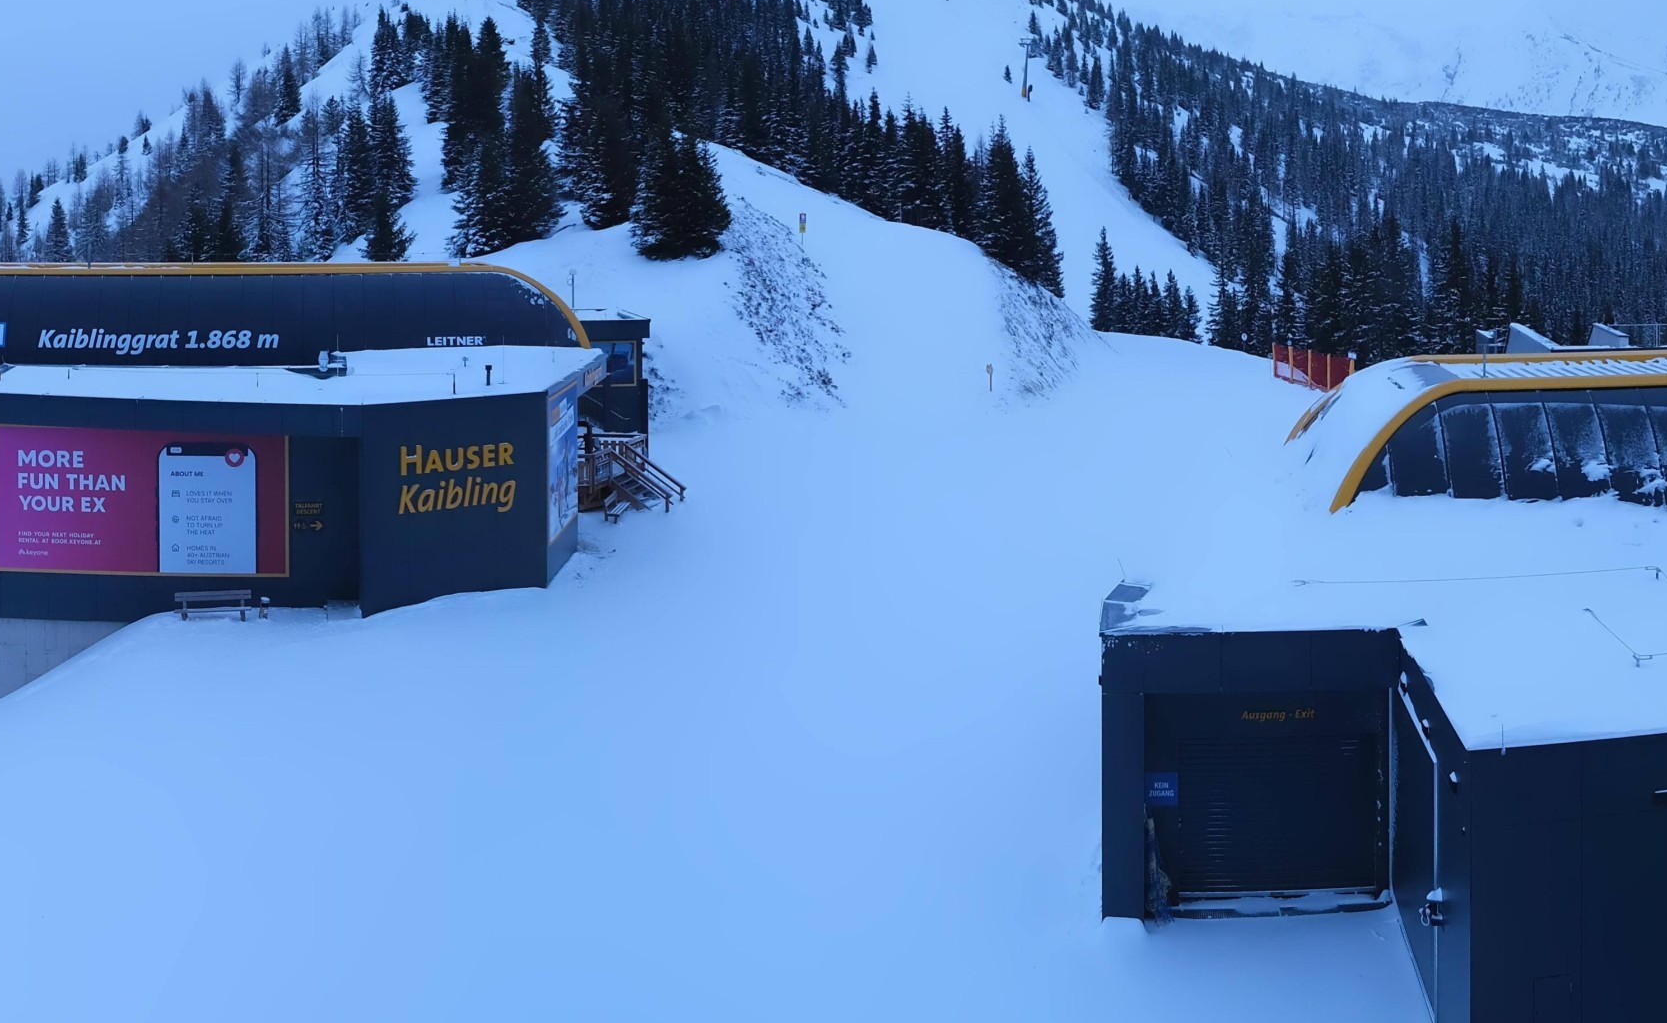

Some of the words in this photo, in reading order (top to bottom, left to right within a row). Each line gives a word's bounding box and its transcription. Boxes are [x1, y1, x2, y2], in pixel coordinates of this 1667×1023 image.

[38, 329, 179, 355] Kaiblinggrat
[185, 330, 252, 348] 1.868
[257, 333, 279, 348] m
[427, 336, 483, 346] LEITNER
[17, 449, 84, 468] MORE
[17, 472, 58, 489] FUN
[66, 474, 126, 491] THAN
[19, 495, 74, 512] YOUR
[81, 497, 106, 513] EX
[398, 476, 517, 514] Kaibling
[1241, 710, 1286, 721] Ausgang
[1295, 708, 1315, 718] Exit
